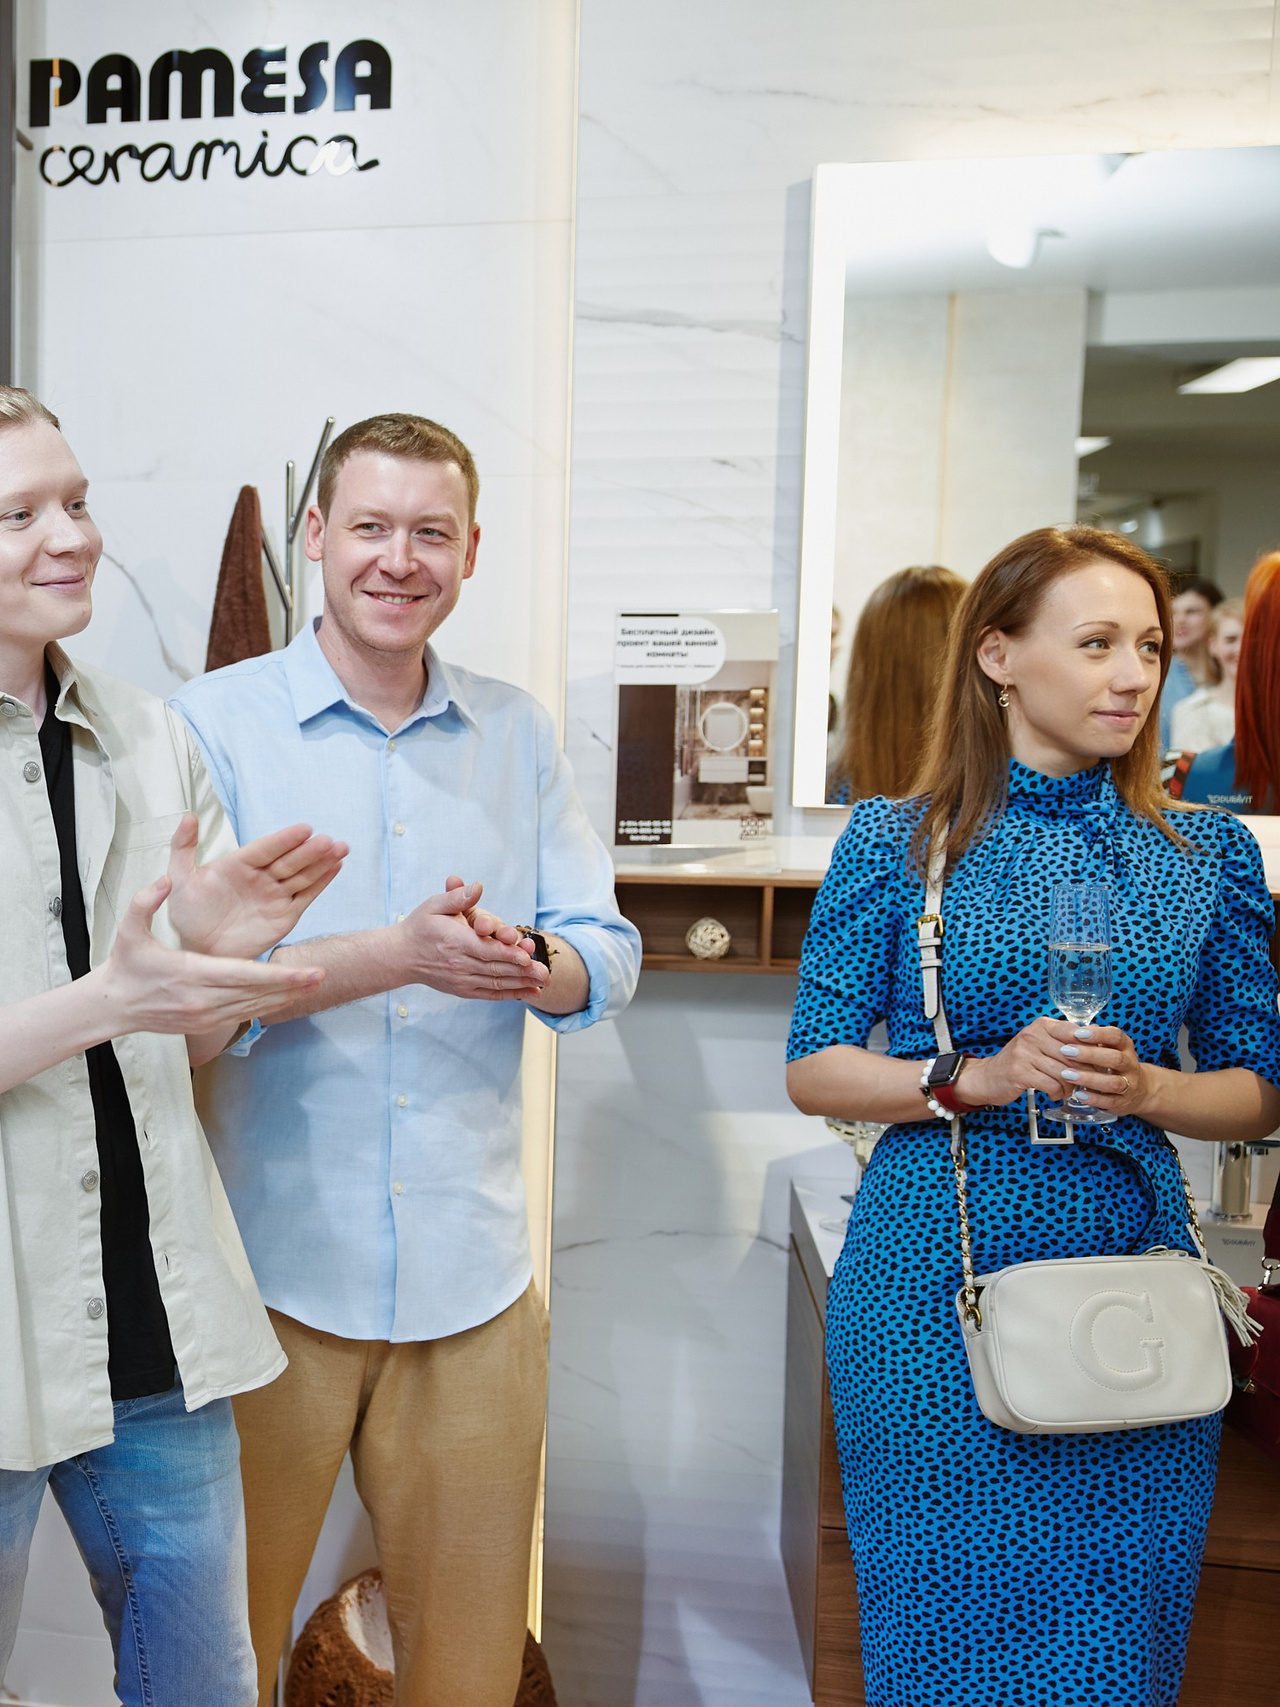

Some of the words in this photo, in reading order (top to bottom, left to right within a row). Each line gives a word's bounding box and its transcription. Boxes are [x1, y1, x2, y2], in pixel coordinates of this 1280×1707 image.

[29, 38, 392, 127] PAMESA
[39, 130, 380, 187] ceramica
[621, 626, 678, 636] Бесплатный
[681, 626, 715, 636] дизайн
[652, 638, 682, 647] вашей
[685, 638, 718, 647] ванной
[1068, 1289, 1165, 1392] G
